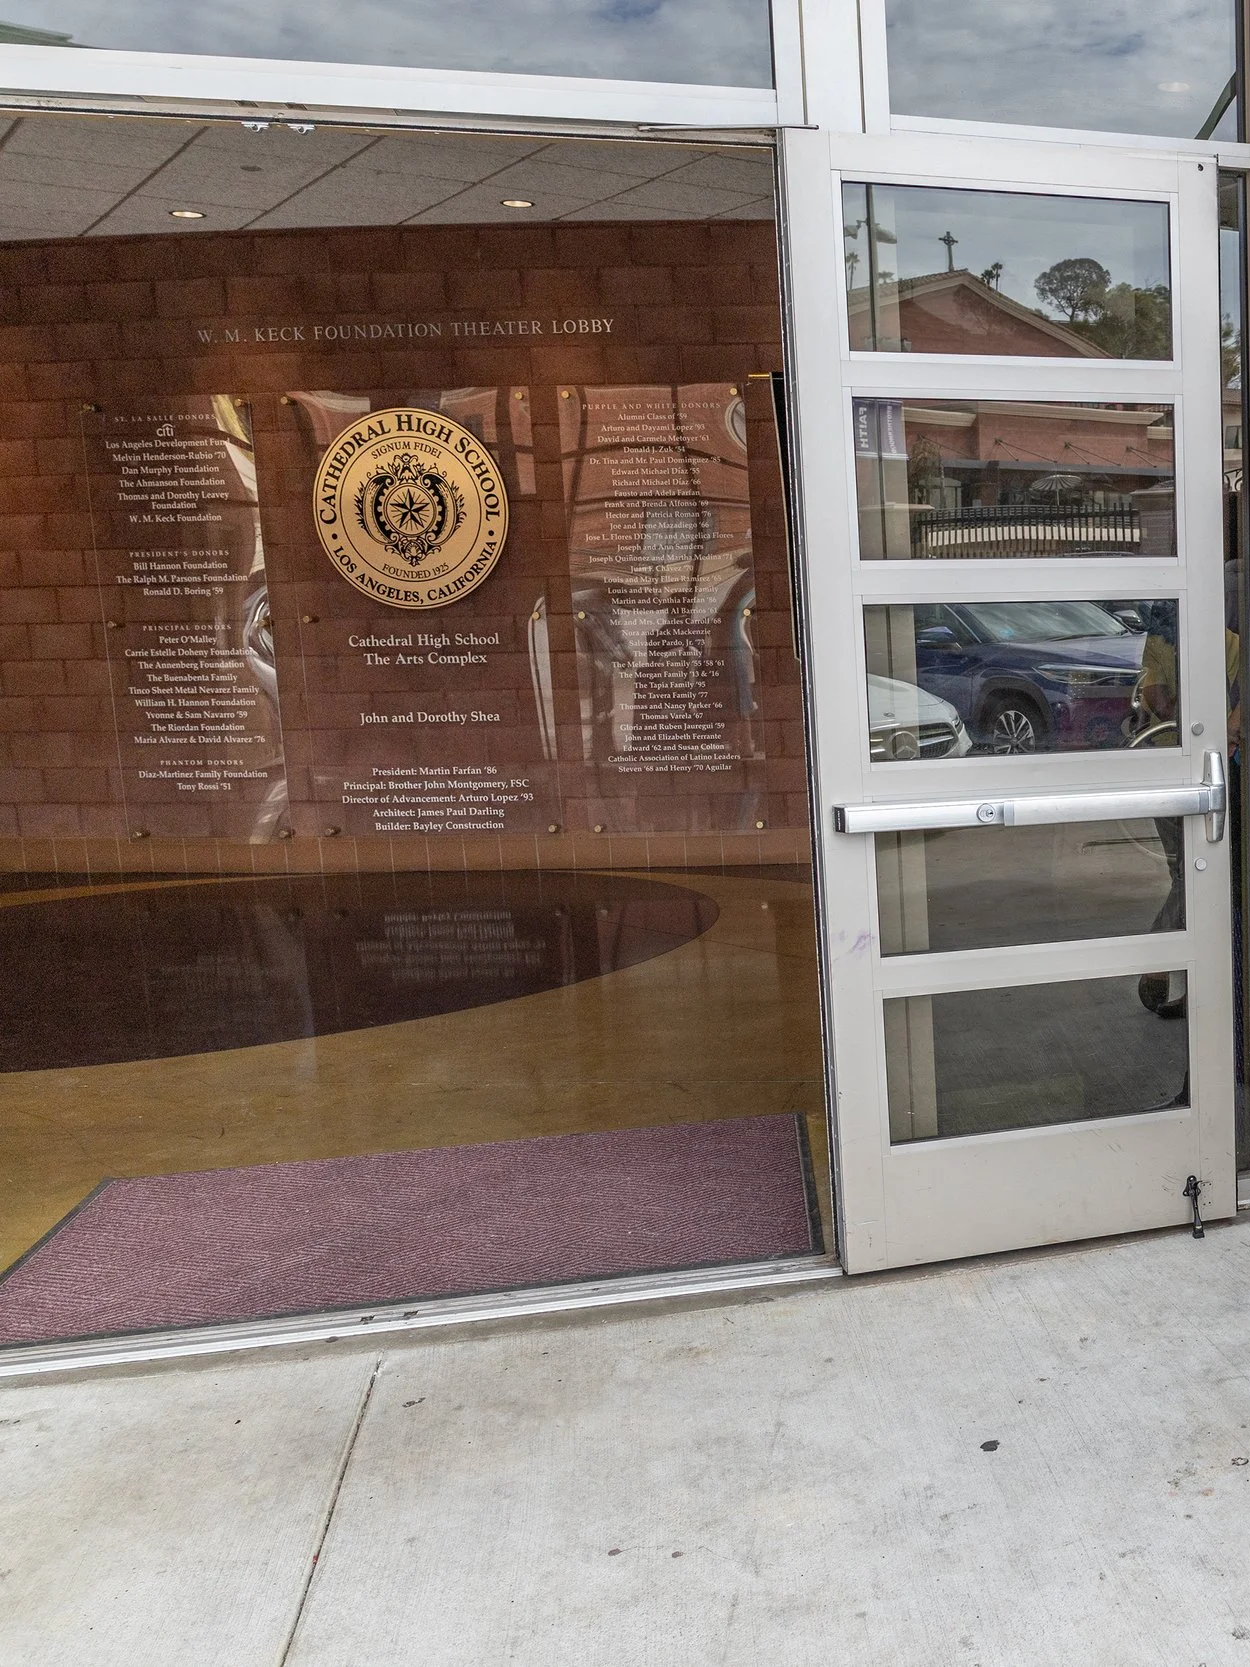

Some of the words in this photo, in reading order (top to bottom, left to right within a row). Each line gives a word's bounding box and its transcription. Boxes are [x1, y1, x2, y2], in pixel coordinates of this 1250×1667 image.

[197, 330, 218, 344] W.
[224, 329, 247, 343] M.
[255, 327, 305, 342] KECK
[314, 323, 443, 340] FOUNDATION
[450, 321, 543, 337] THEATER
[552, 319, 614, 335] LOBBY
[156, 424, 174, 437] citi
[106, 440, 120, 449] Los
[121, 439, 154, 449] Angeles
[155, 438, 208, 449] Development
[113, 453, 141, 462] Melvin
[143, 451, 213, 461] Henderson-Rubio
[372, 442, 411, 460] SIGNUM
[414, 443, 442, 459] FIDEI
[122, 466, 139, 475] Dan
[140, 465, 172, 476] Murphy
[174, 464, 220, 474] Foundation
[320, 420, 392, 525] CATHEDRAL
[395, 413, 455, 444] HIGH
[454, 437, 501, 522] SCHOOL
[119, 479, 134, 488] The
[136, 478, 179, 488] Ahmanson
[180, 477, 225, 487] Foundation
[117, 492, 149, 501] Thomas
[150, 492, 165, 500] and
[167, 491, 199, 501] Dorothy
[201, 490, 229, 501] Leavey
[152, 500, 197, 510] Foundation
[129, 515, 141, 523] W.
[143, 514, 153, 523] M.
[155, 514, 175, 523] Keck
[177, 513, 222, 522] Foundation
[133, 562, 148, 571] Bill
[150, 562, 181, 570] Hannon
[183, 561, 228, 570] Foundation
[382, 563, 431, 579] FOUNDED
[432, 563, 450, 576] 1925
[116, 576, 132, 584] The
[133, 575, 157, 584] Ralph
[158, 575, 169, 583] M.
[171, 574, 202, 583] Parsons
[203, 573, 248, 582] Foundation
[333, 546, 357, 574] LOS
[355, 573, 424, 605] ANGELES,
[427, 541, 497, 601] CALIFORNIA
[143, 587, 171, 596] Ronald
[173, 587, 183, 596] D.
[184, 587, 211, 597] Boring
[159, 636, 179, 644] Peter
[348, 634, 412, 647] Cathedral
[417, 633, 450, 649] High
[454, 633, 500, 646] School
[364, 653, 390, 666] The
[395, 652, 424, 665] Arts
[428, 651, 487, 667] Complex
[138, 661, 153, 670] The
[155, 661, 199, 671] Annenberg
[200, 660, 245, 669] Foundation
[147, 674, 162, 682] The
[211, 673, 238, 683] Family
[128, 687, 150, 695] Tinco
[152, 686, 173, 695] Sheet
[175, 686, 197, 694] Metal
[199, 685, 231, 694] Nevarez
[233, 685, 259, 695] Family
[135, 699, 166, 707] William
[167, 698, 177, 707] H.
[178, 698, 210, 707] Hannon
[211, 697, 256, 706] Foundation
[146, 711, 174, 719] Yvonne
[176, 711, 184, 719] &
[185, 711, 202, 719] Sam
[203, 710, 235, 719] Navarro
[360, 712, 388, 726] John
[392, 712, 414, 723] and
[417, 711, 467, 725] Dorothy
[470, 711, 501, 722] Shea
[640, 712, 668, 720] Thomas
[670, 712, 692, 720] Varela
[151, 723, 166, 732] The
[168, 723, 199, 731] Riordan
[200, 722, 245, 731] Foundation
[620, 723, 642, 731] Gloria
[644, 723, 657, 731] and
[659, 722, 682, 730] Ruben
[684, 722, 714, 732] Jauregui
[134, 736, 157, 744] Maria
[158, 735, 188, 744] Alvarez
[190, 735, 197, 744] &
[198, 735, 222, 743] David
[223, 735, 253, 743] Alvarez
[625, 733, 641, 743] John
[643, 733, 656, 741] and
[658, 733, 691, 741] Elizabeth
[692, 732, 722, 740] Ferrante
[608, 754, 638, 762] Catholic
[639, 754, 679, 762] Association
[680, 753, 689, 761] of
[689, 753, 712, 761] Latino
[714, 753, 741, 761] Leaders
[372, 767, 417, 776] President:
[419, 766, 450, 775] Martin
[618, 765, 642, 773] Steven
[655, 764, 668, 772] and
[670, 764, 692, 773] Henry
[705, 763, 732, 773] Aguilar
[195, 770, 222, 780] Family
[223, 770, 268, 778] Foundation
[177, 782, 196, 792] Tony
[198, 782, 219, 790] Rossi
[344, 781, 387, 792] Principal:
[389, 780, 422, 790] Brother
[423, 780, 446, 791] John
[448, 779, 508, 790] Montgomery,
[510, 779, 530, 788] FSC
[342, 795, 378, 804] Director
[380, 794, 390, 803] of
[392, 793, 456, 803] Advancement:
[458, 793, 489, 802] Arturo
[491, 792, 519, 804] Lopez
[373, 808, 416, 817] Architect:
[417, 807, 444, 819] James
[446, 807, 467, 816] Paul
[469, 806, 505, 818] Darling
[375, 821, 411, 831] Builder:
[413, 821, 444, 832] Bayley
[446, 820, 504, 830] Construction
